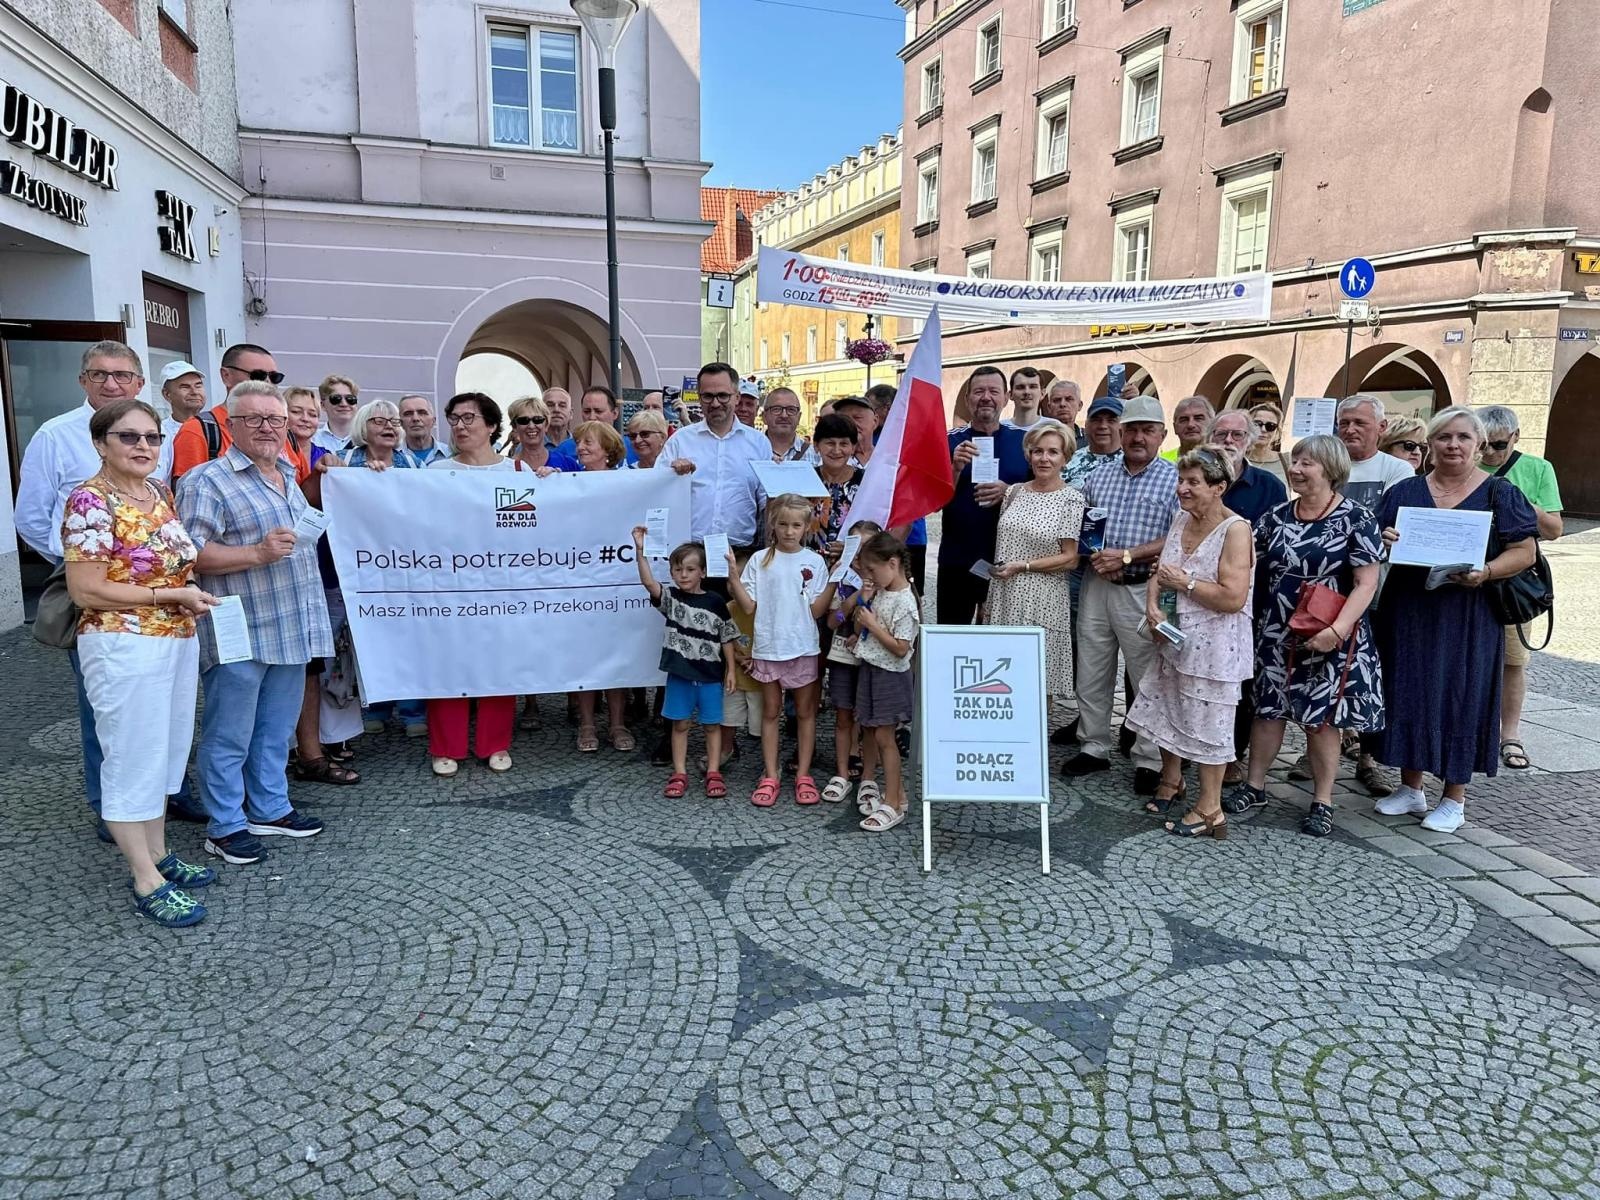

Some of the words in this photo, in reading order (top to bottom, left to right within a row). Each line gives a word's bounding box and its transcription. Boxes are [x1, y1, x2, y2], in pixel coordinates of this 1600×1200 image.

[9, 162, 88, 227] ZŁOTNIK
[783, 289, 817, 303] GODZ.
[952, 281, 1063, 300] RACIBORSKI
[1067, 285, 1145, 303] FESTIWAL
[1149, 282, 1236, 300] MUZEALNY
[145, 299, 180, 329] REBRO
[496, 513, 515, 521] TAK
[518, 513, 536, 521] DLA
[356, 549, 442, 569] Polska
[452, 547, 592, 573] potrzebuje
[358, 604, 406, 618] Masz
[411, 603, 452, 617] inne
[457, 600, 527, 617] zdanie?
[533, 596, 618, 614] Przekonaj
[624, 597, 652, 609] mn
[953, 696, 981, 709] TAK
[985, 696, 1013, 709] DLA
[953, 709, 1014, 720] ROZWOJU
[956, 752, 1014, 767] DOŁĄCZ
[956, 769, 977, 782] DO
[980, 770, 1014, 782] NAS!
